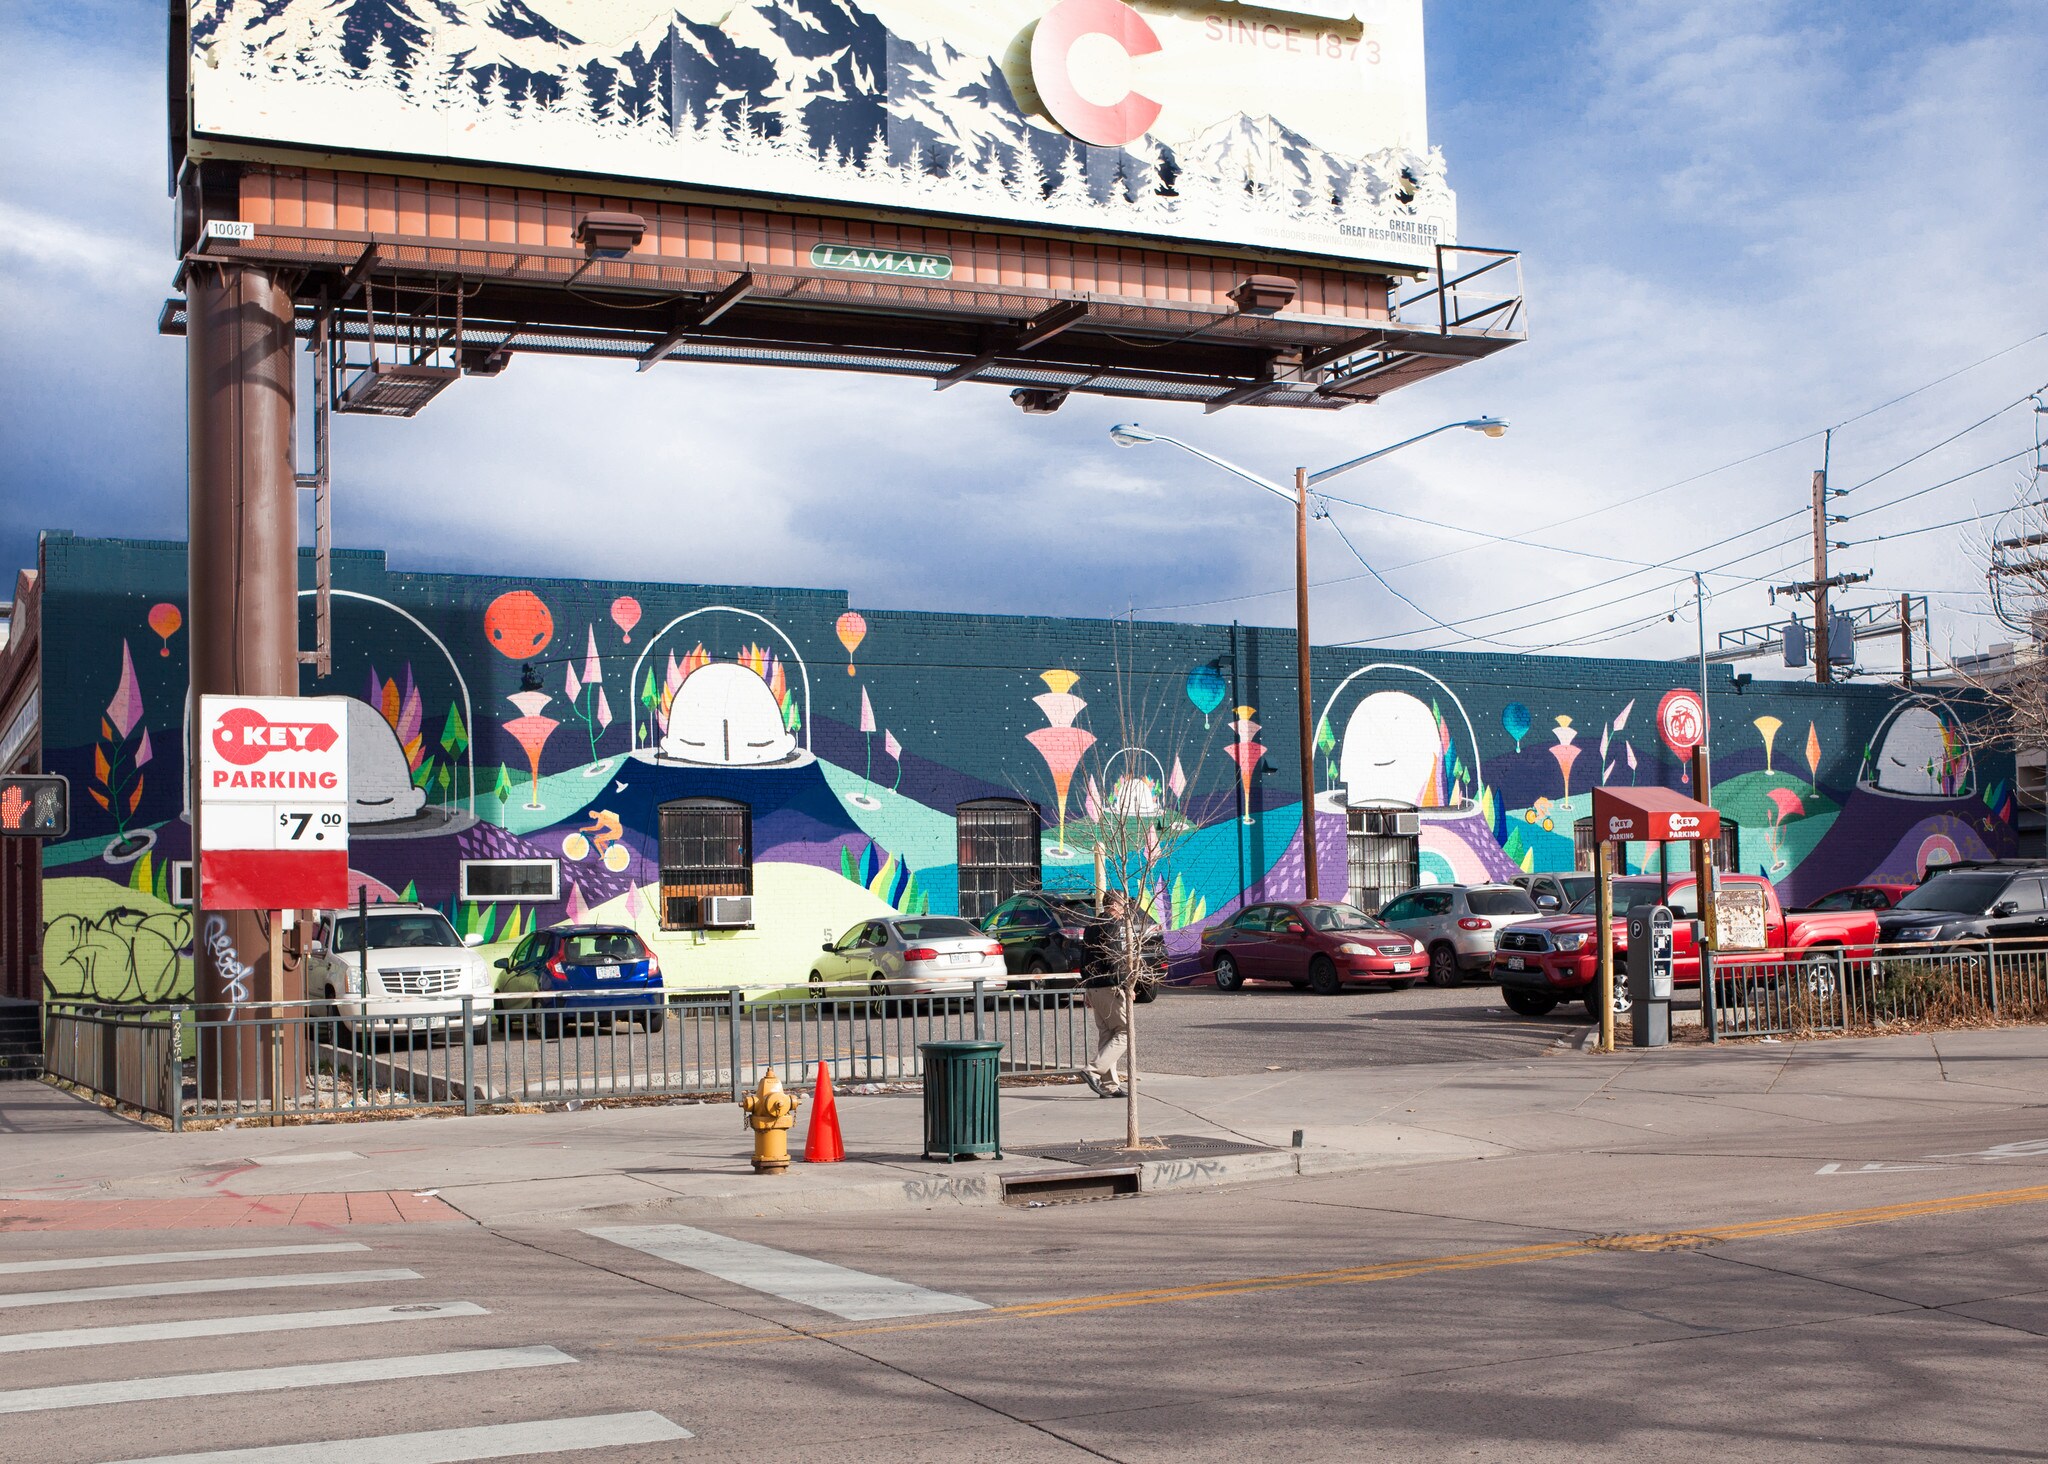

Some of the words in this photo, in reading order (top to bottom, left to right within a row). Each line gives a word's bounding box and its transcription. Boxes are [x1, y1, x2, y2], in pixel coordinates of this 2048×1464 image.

[1205, 14, 1301, 54] SINCE
[1315, 29, 1381, 65] 1873
[214, 223, 248, 236] 10087
[1339, 224, 1367, 237] GREAT
[1368, 228, 1438, 246] RESPONSIBILITY
[1389, 218, 1415, 233] GREAT
[1418, 223, 1438, 236] BEER
[823, 248, 938, 274] LAMAR
[243, 726, 313, 746] KEY
[213, 770, 338, 789] PARKING
[1614, 820, 1629, 828] KEY
[1609, 833, 1634, 841] PARKING
[1669, 830, 1700, 838] PARKING
[823, 928, 833, 942] 5
